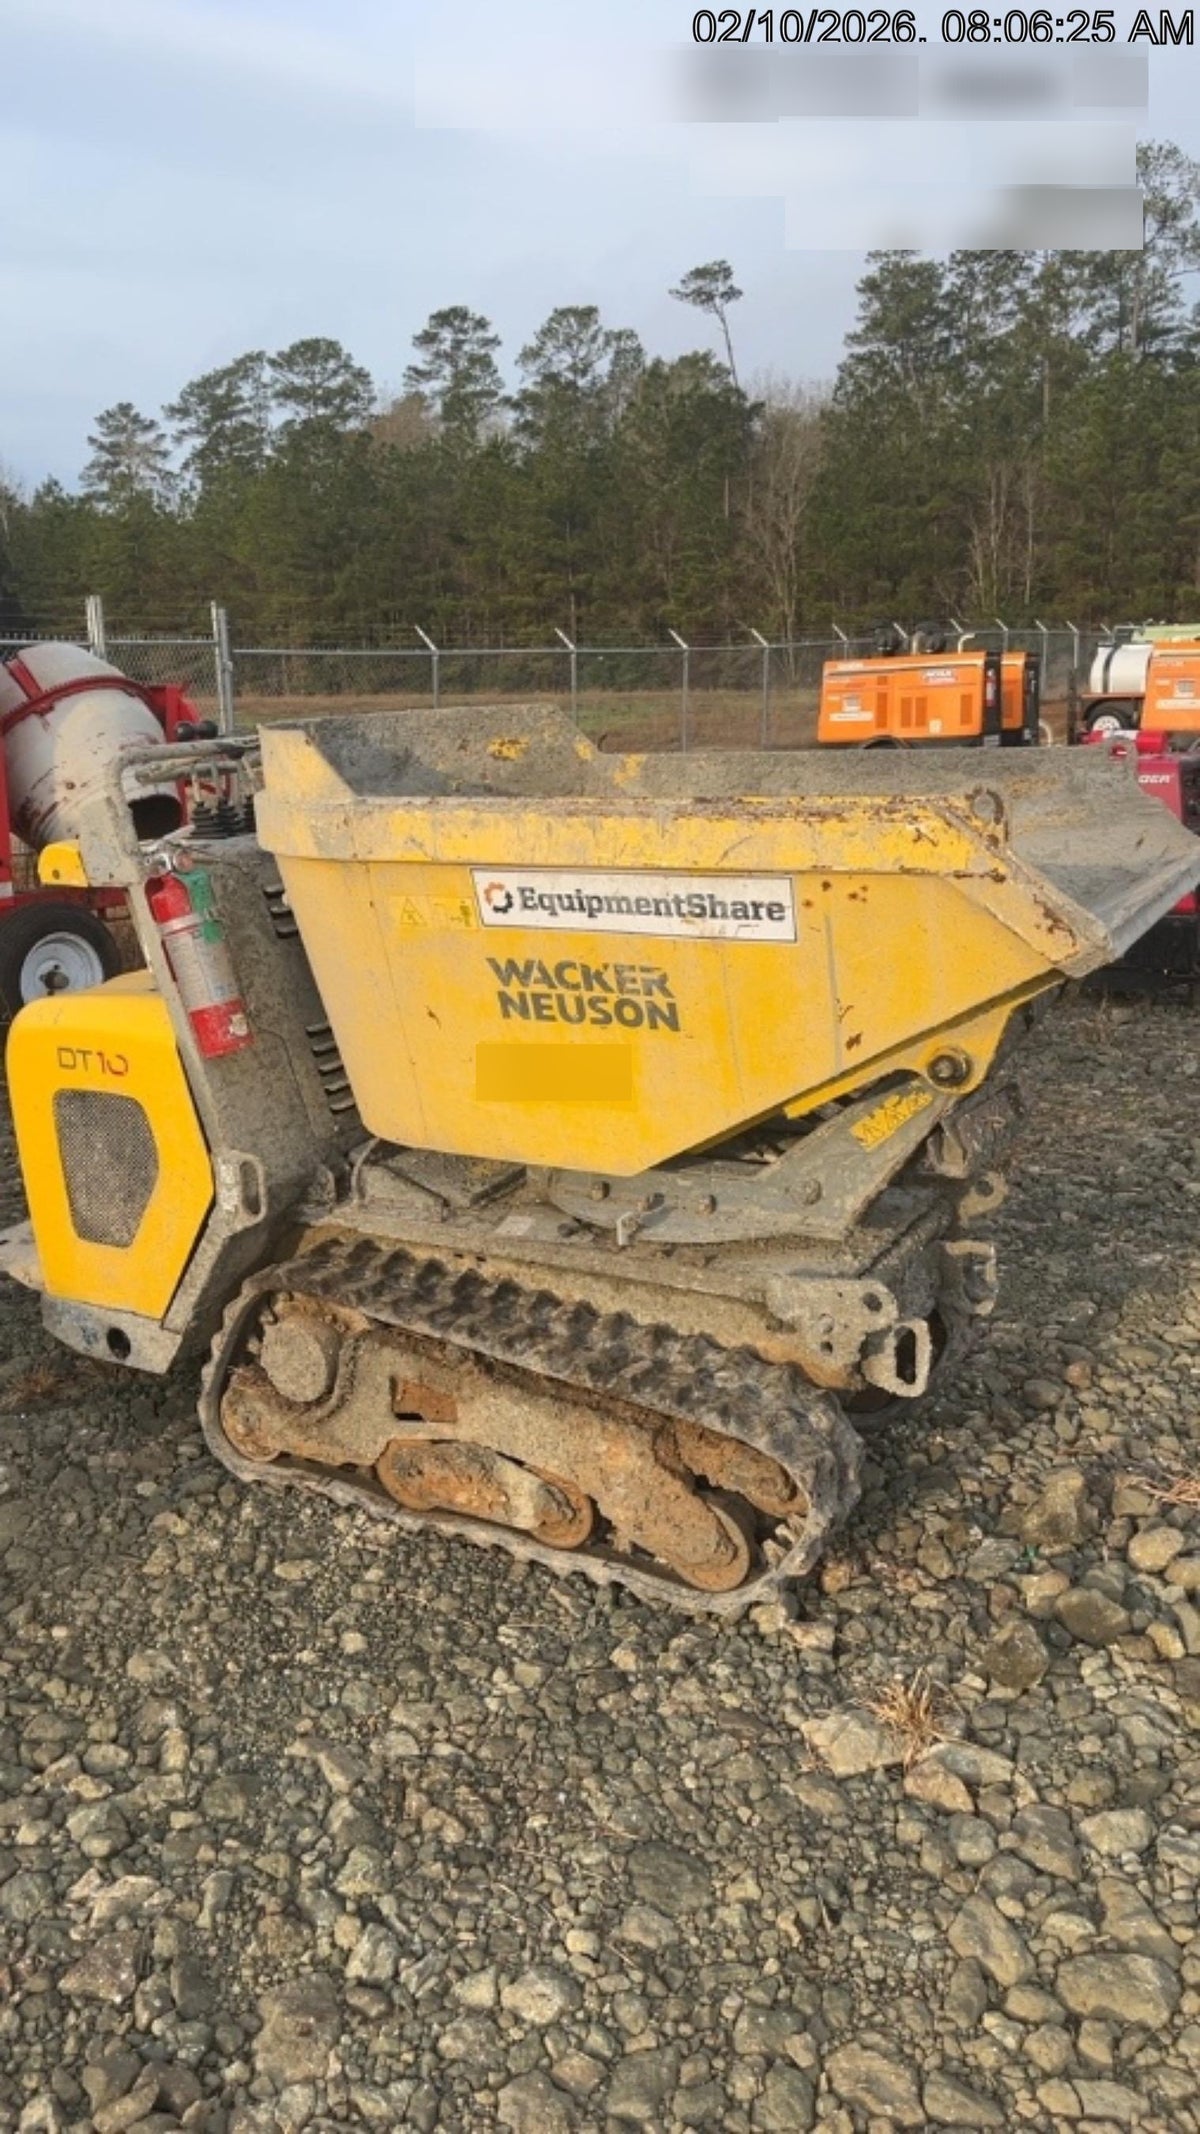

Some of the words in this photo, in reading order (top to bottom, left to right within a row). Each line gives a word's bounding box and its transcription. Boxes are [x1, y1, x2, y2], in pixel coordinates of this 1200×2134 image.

[517, 887, 786, 921] EquipmentShare
[486, 957, 675, 998] WACKER
[497, 991, 681, 1032] NEUSON
[57, 1047, 129, 1076] DT10
